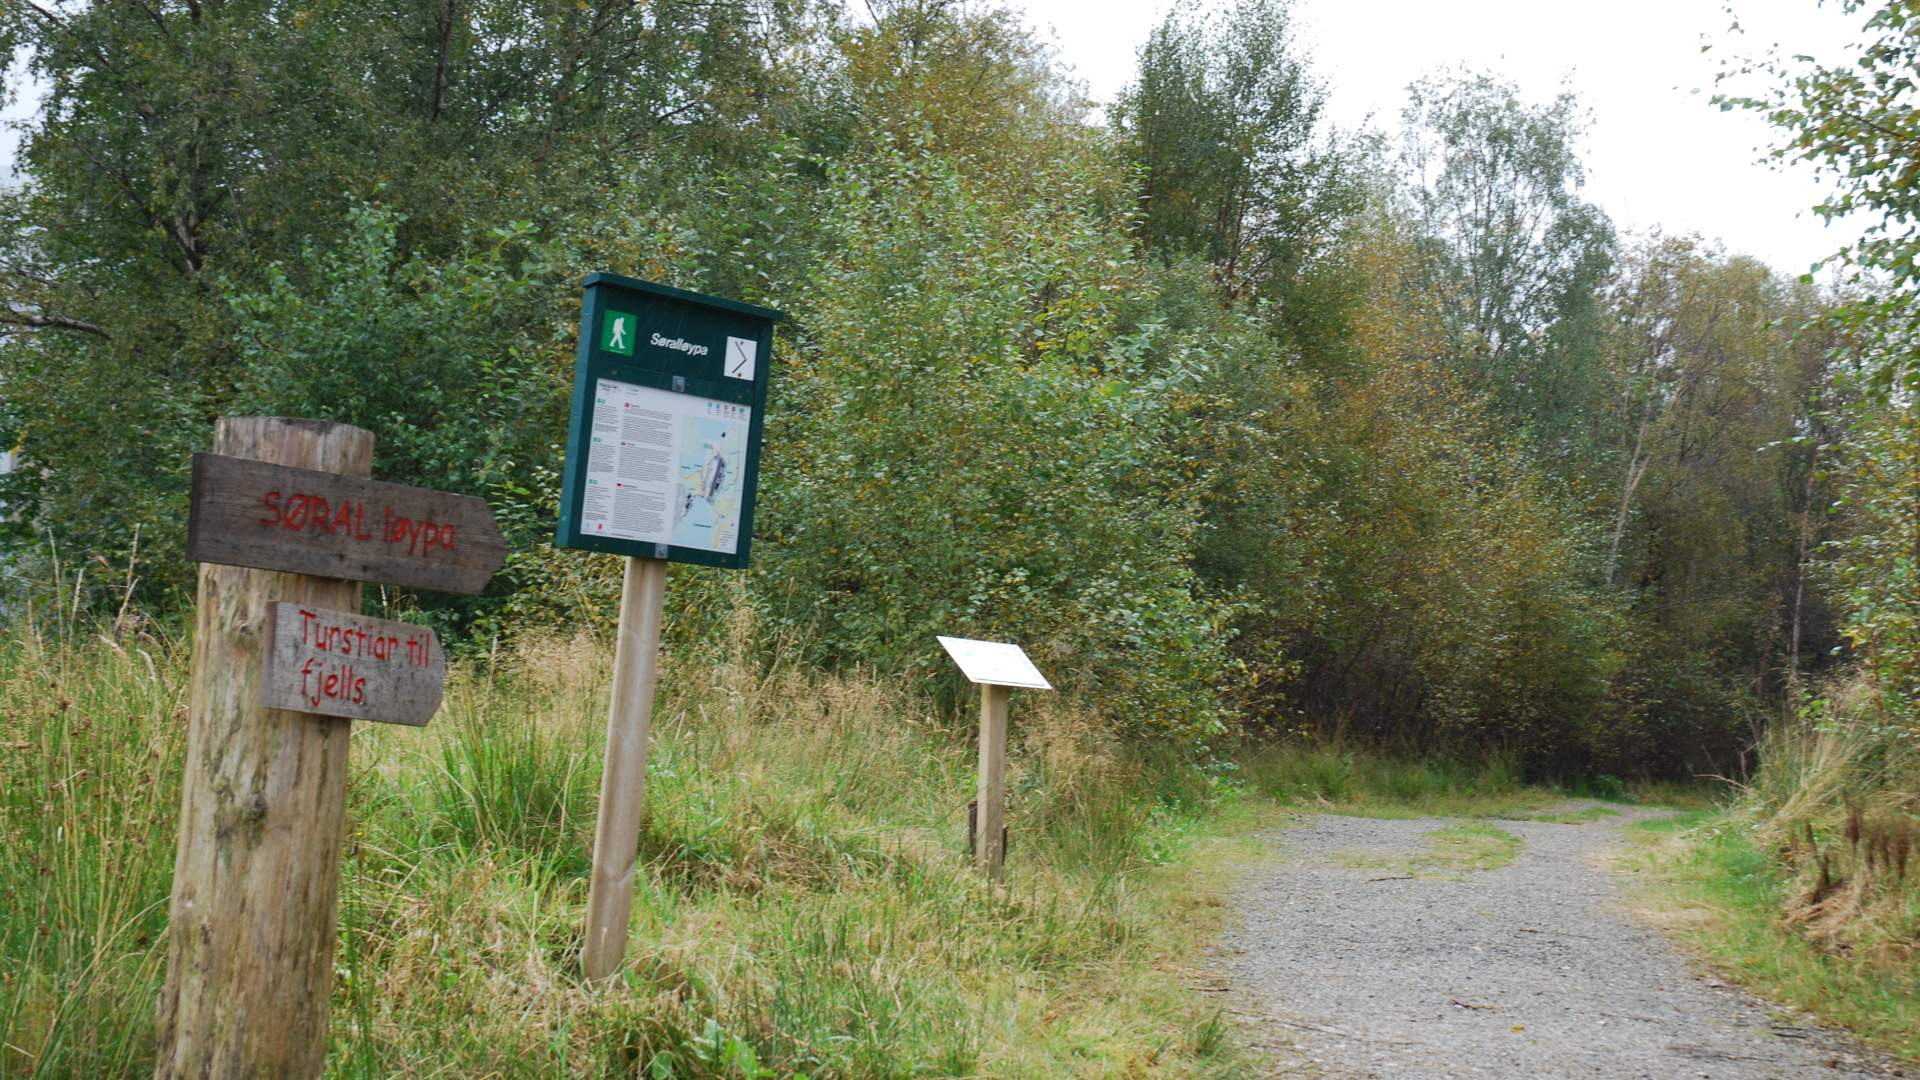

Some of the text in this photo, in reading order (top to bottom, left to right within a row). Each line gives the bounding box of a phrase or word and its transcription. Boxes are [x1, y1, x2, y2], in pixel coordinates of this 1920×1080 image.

[650, 332, 709, 356] Søralløypa
[257, 490, 456, 557] SØRAL løypa
[299, 609, 431, 669] Turstiar til
[301, 657, 366, 707] fjells
